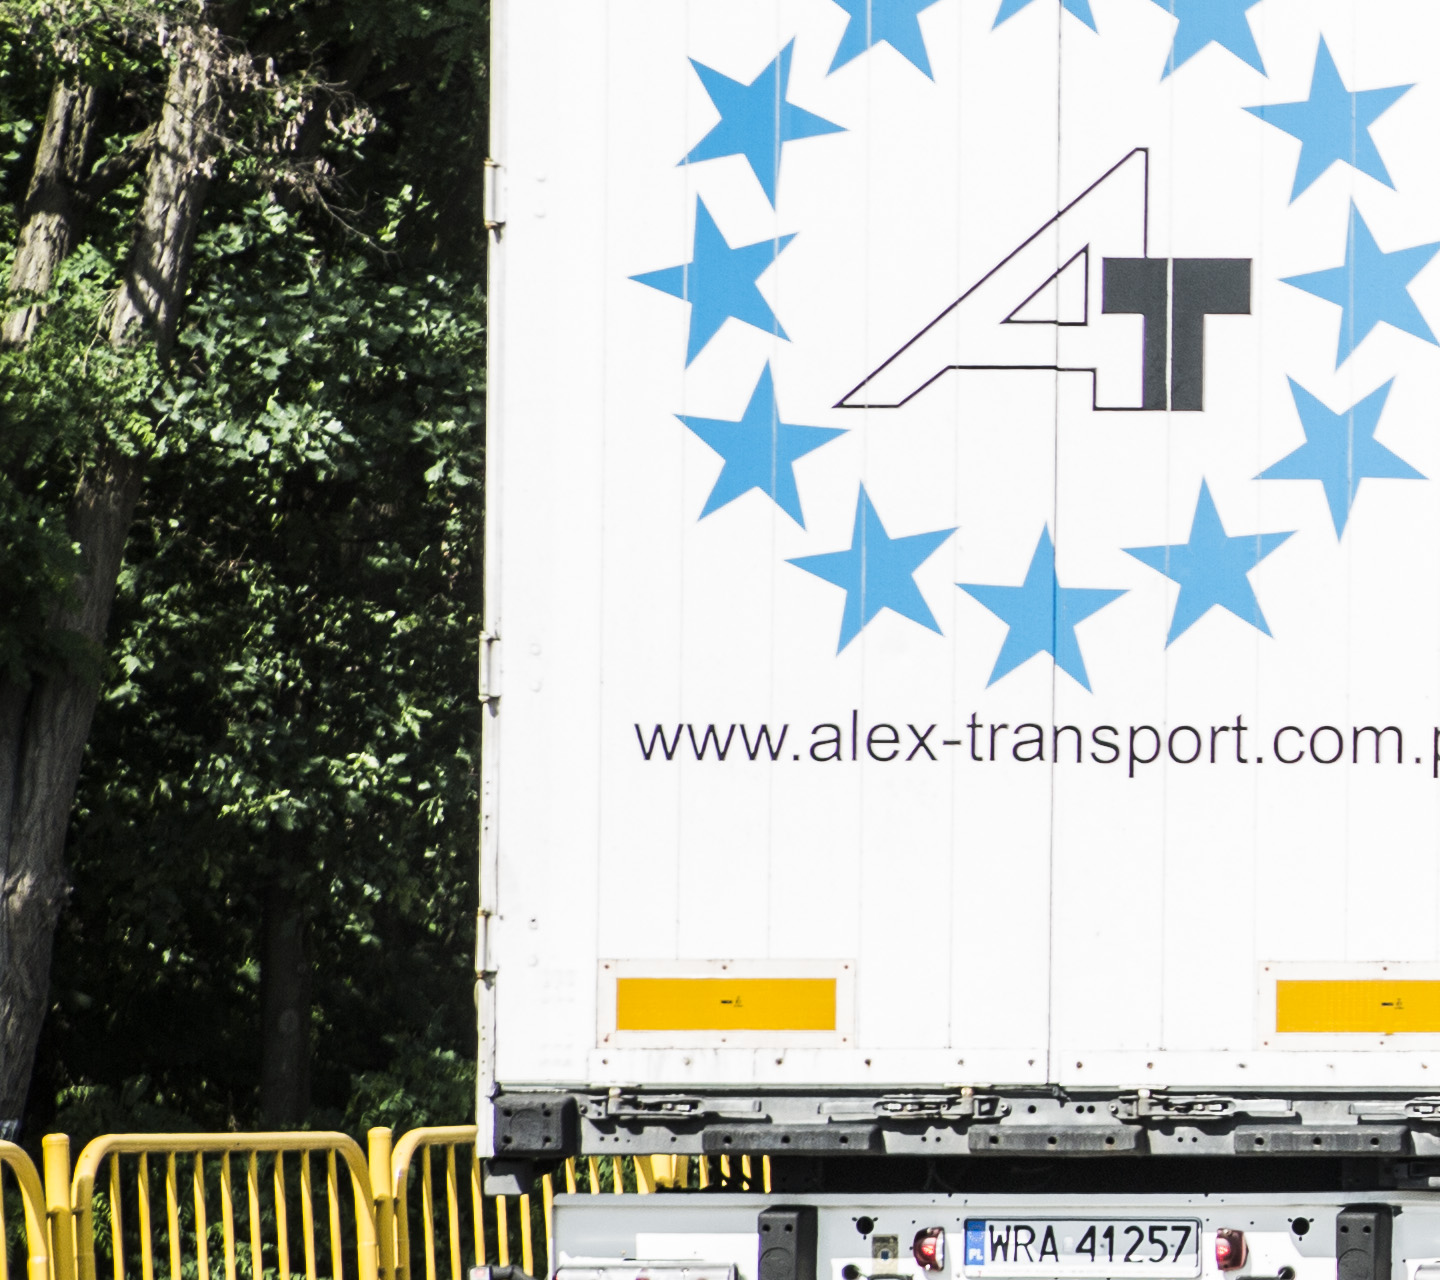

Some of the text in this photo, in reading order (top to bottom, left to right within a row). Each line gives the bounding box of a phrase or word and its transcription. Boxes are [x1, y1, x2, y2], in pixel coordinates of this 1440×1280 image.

[968, 1225, 1192, 1263] PL WRA 41257
